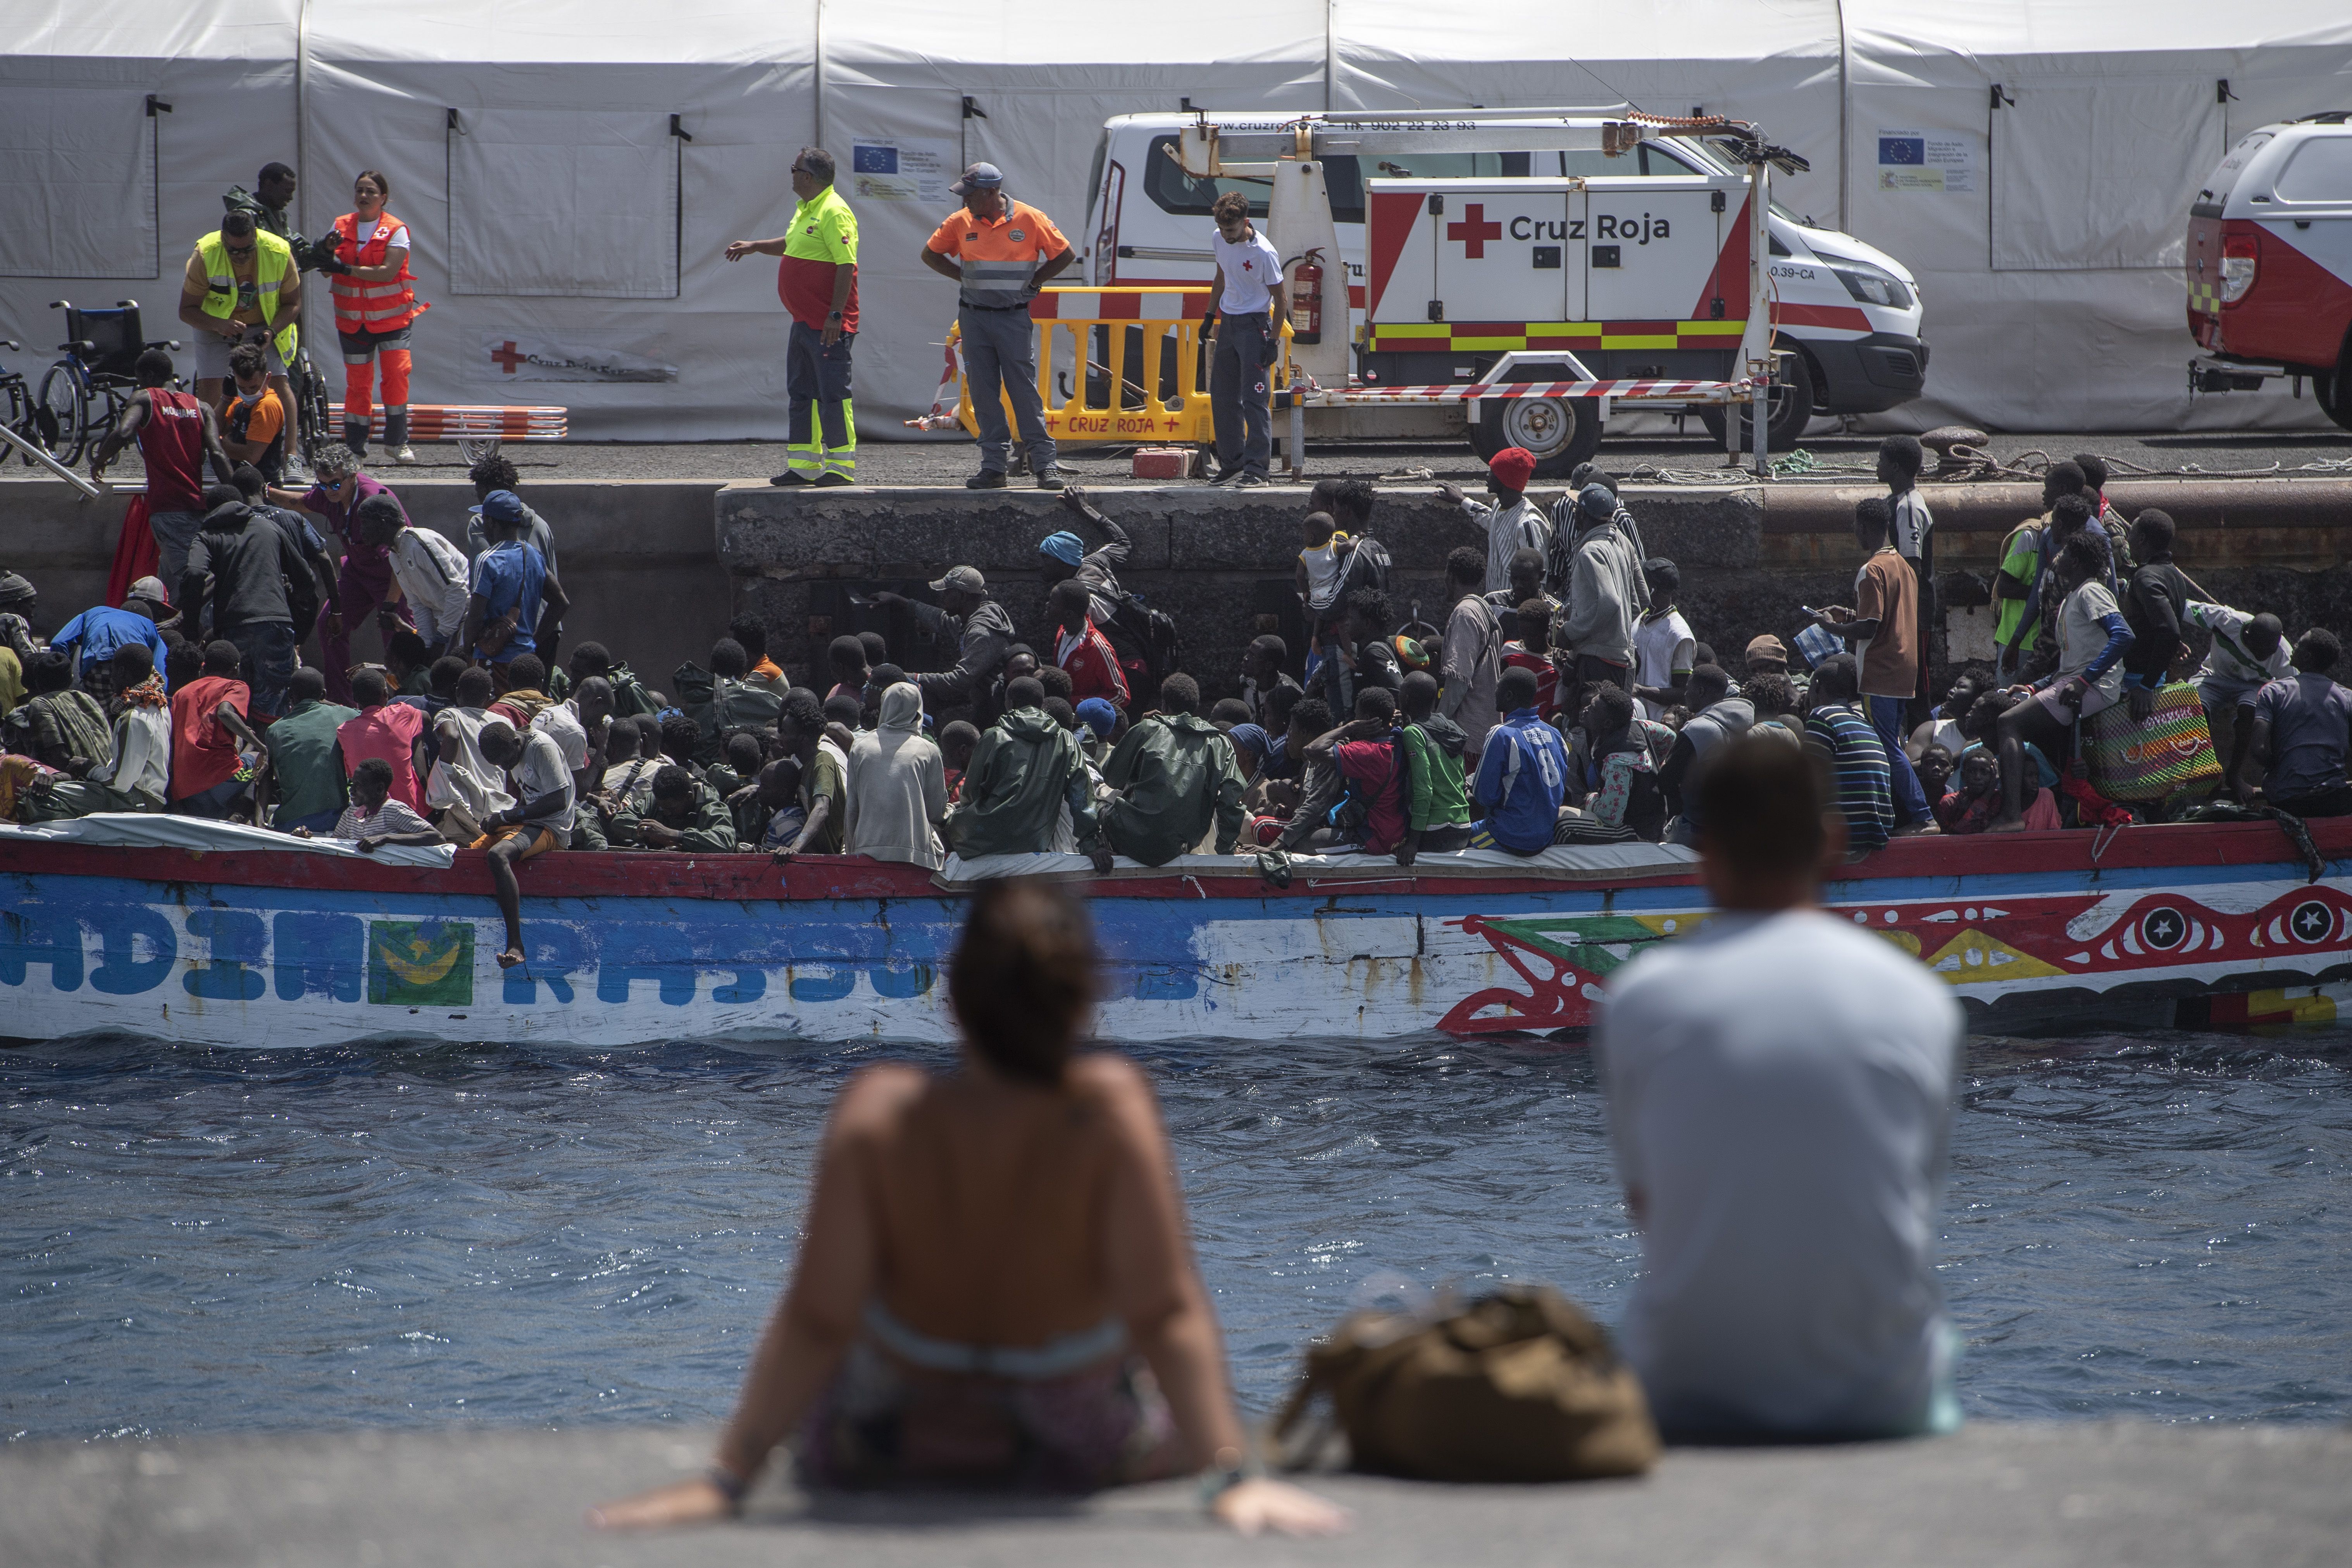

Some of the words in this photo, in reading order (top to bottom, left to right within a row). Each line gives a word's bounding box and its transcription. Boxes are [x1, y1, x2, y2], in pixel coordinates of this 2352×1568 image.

[1372, 121, 1400, 130] 902
[1407, 121, 1425, 130] 22
[1432, 121, 1450, 130] 23
[1457, 121, 1475, 130] 93
[1510, 215, 1585, 240] Cruz
[1597, 212, 1670, 245] Roja
[1069, 417, 1110, 433] CRUZ
[1117, 418, 1154, 433] ROJA
[1538, 748, 1560, 787] 8
